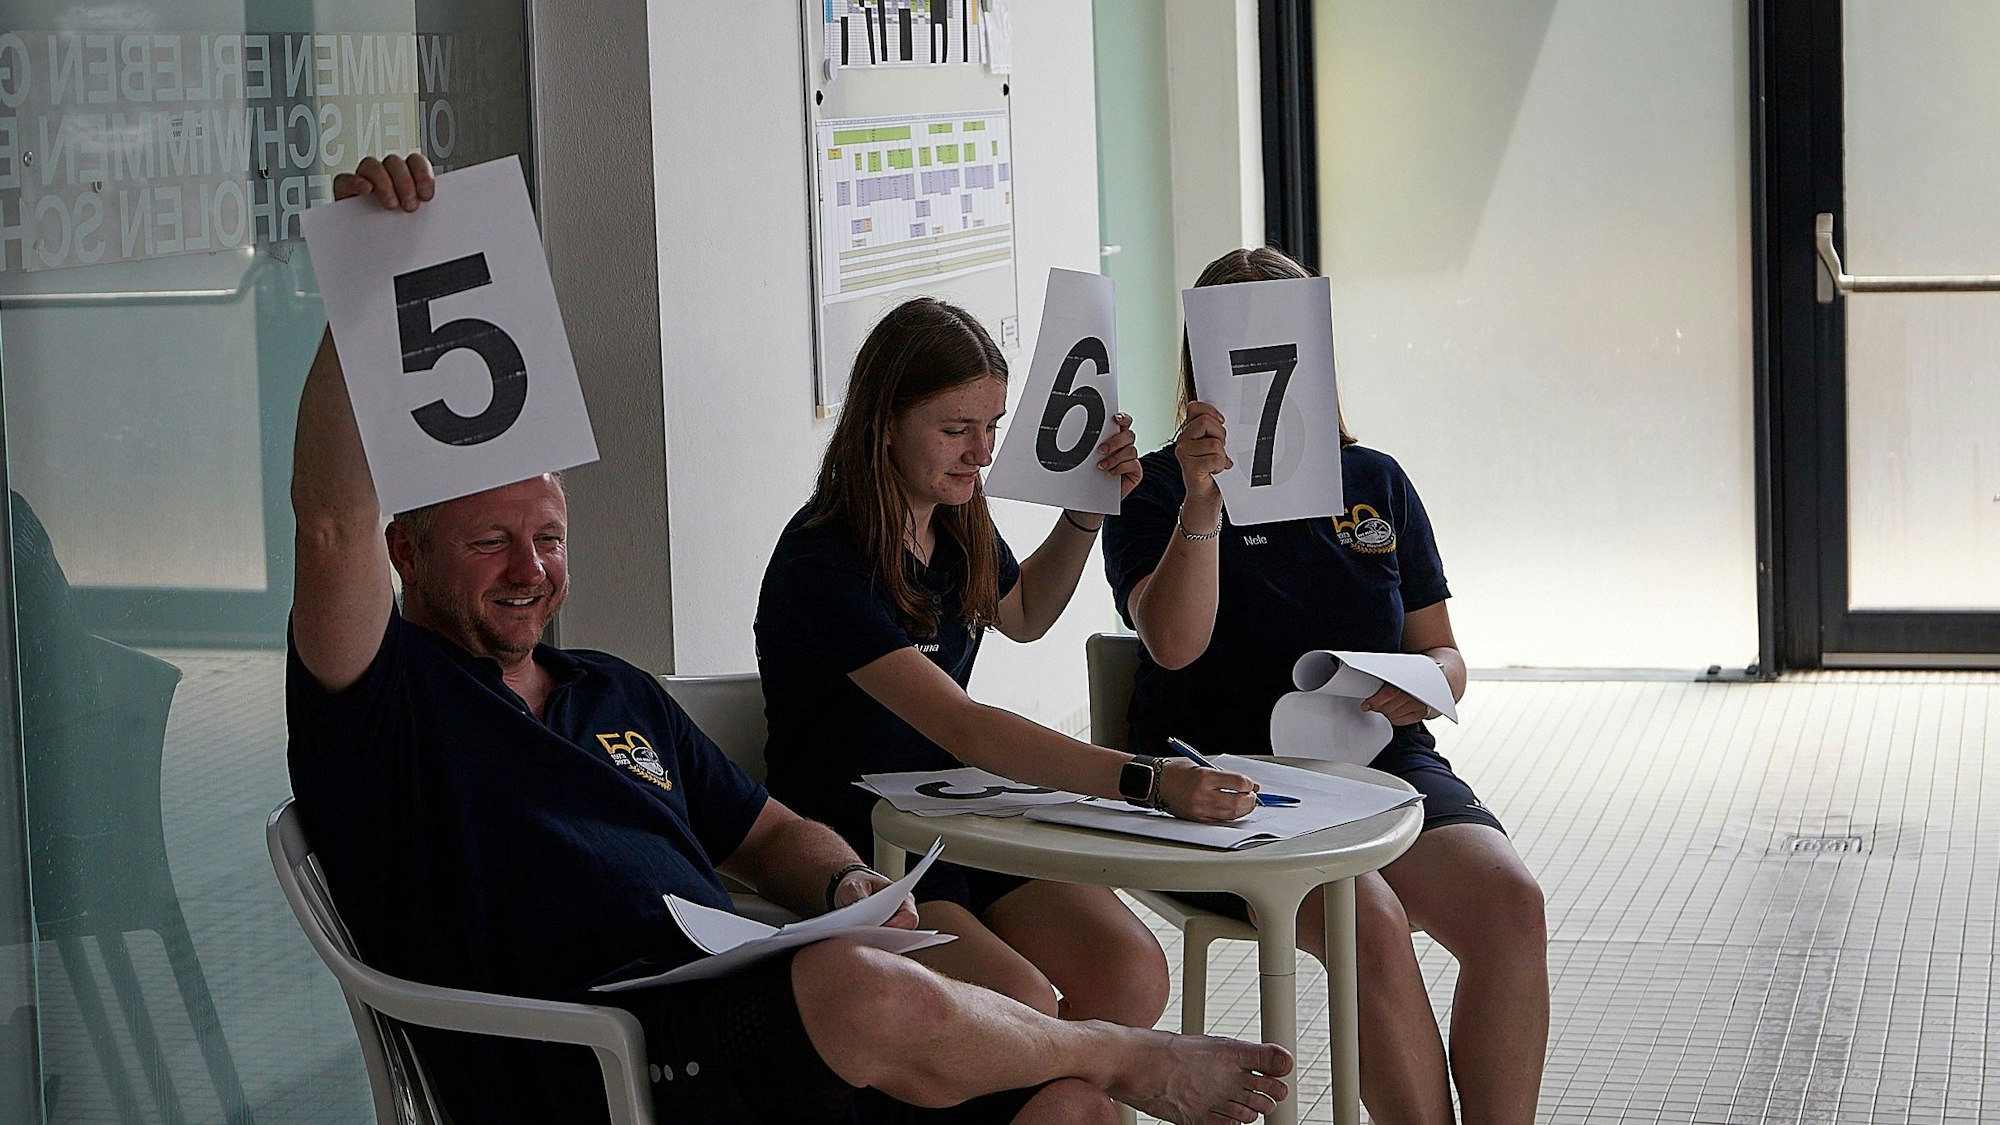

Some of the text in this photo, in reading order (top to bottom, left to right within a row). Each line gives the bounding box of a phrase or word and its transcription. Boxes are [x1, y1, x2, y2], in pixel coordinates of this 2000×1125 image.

[393, 251, 528, 446] 5
[1035, 336, 1111, 472] 6
[1229, 343, 1299, 488] 7
[1243, 534, 1268, 546] Nele
[596, 731, 654, 754] 50
